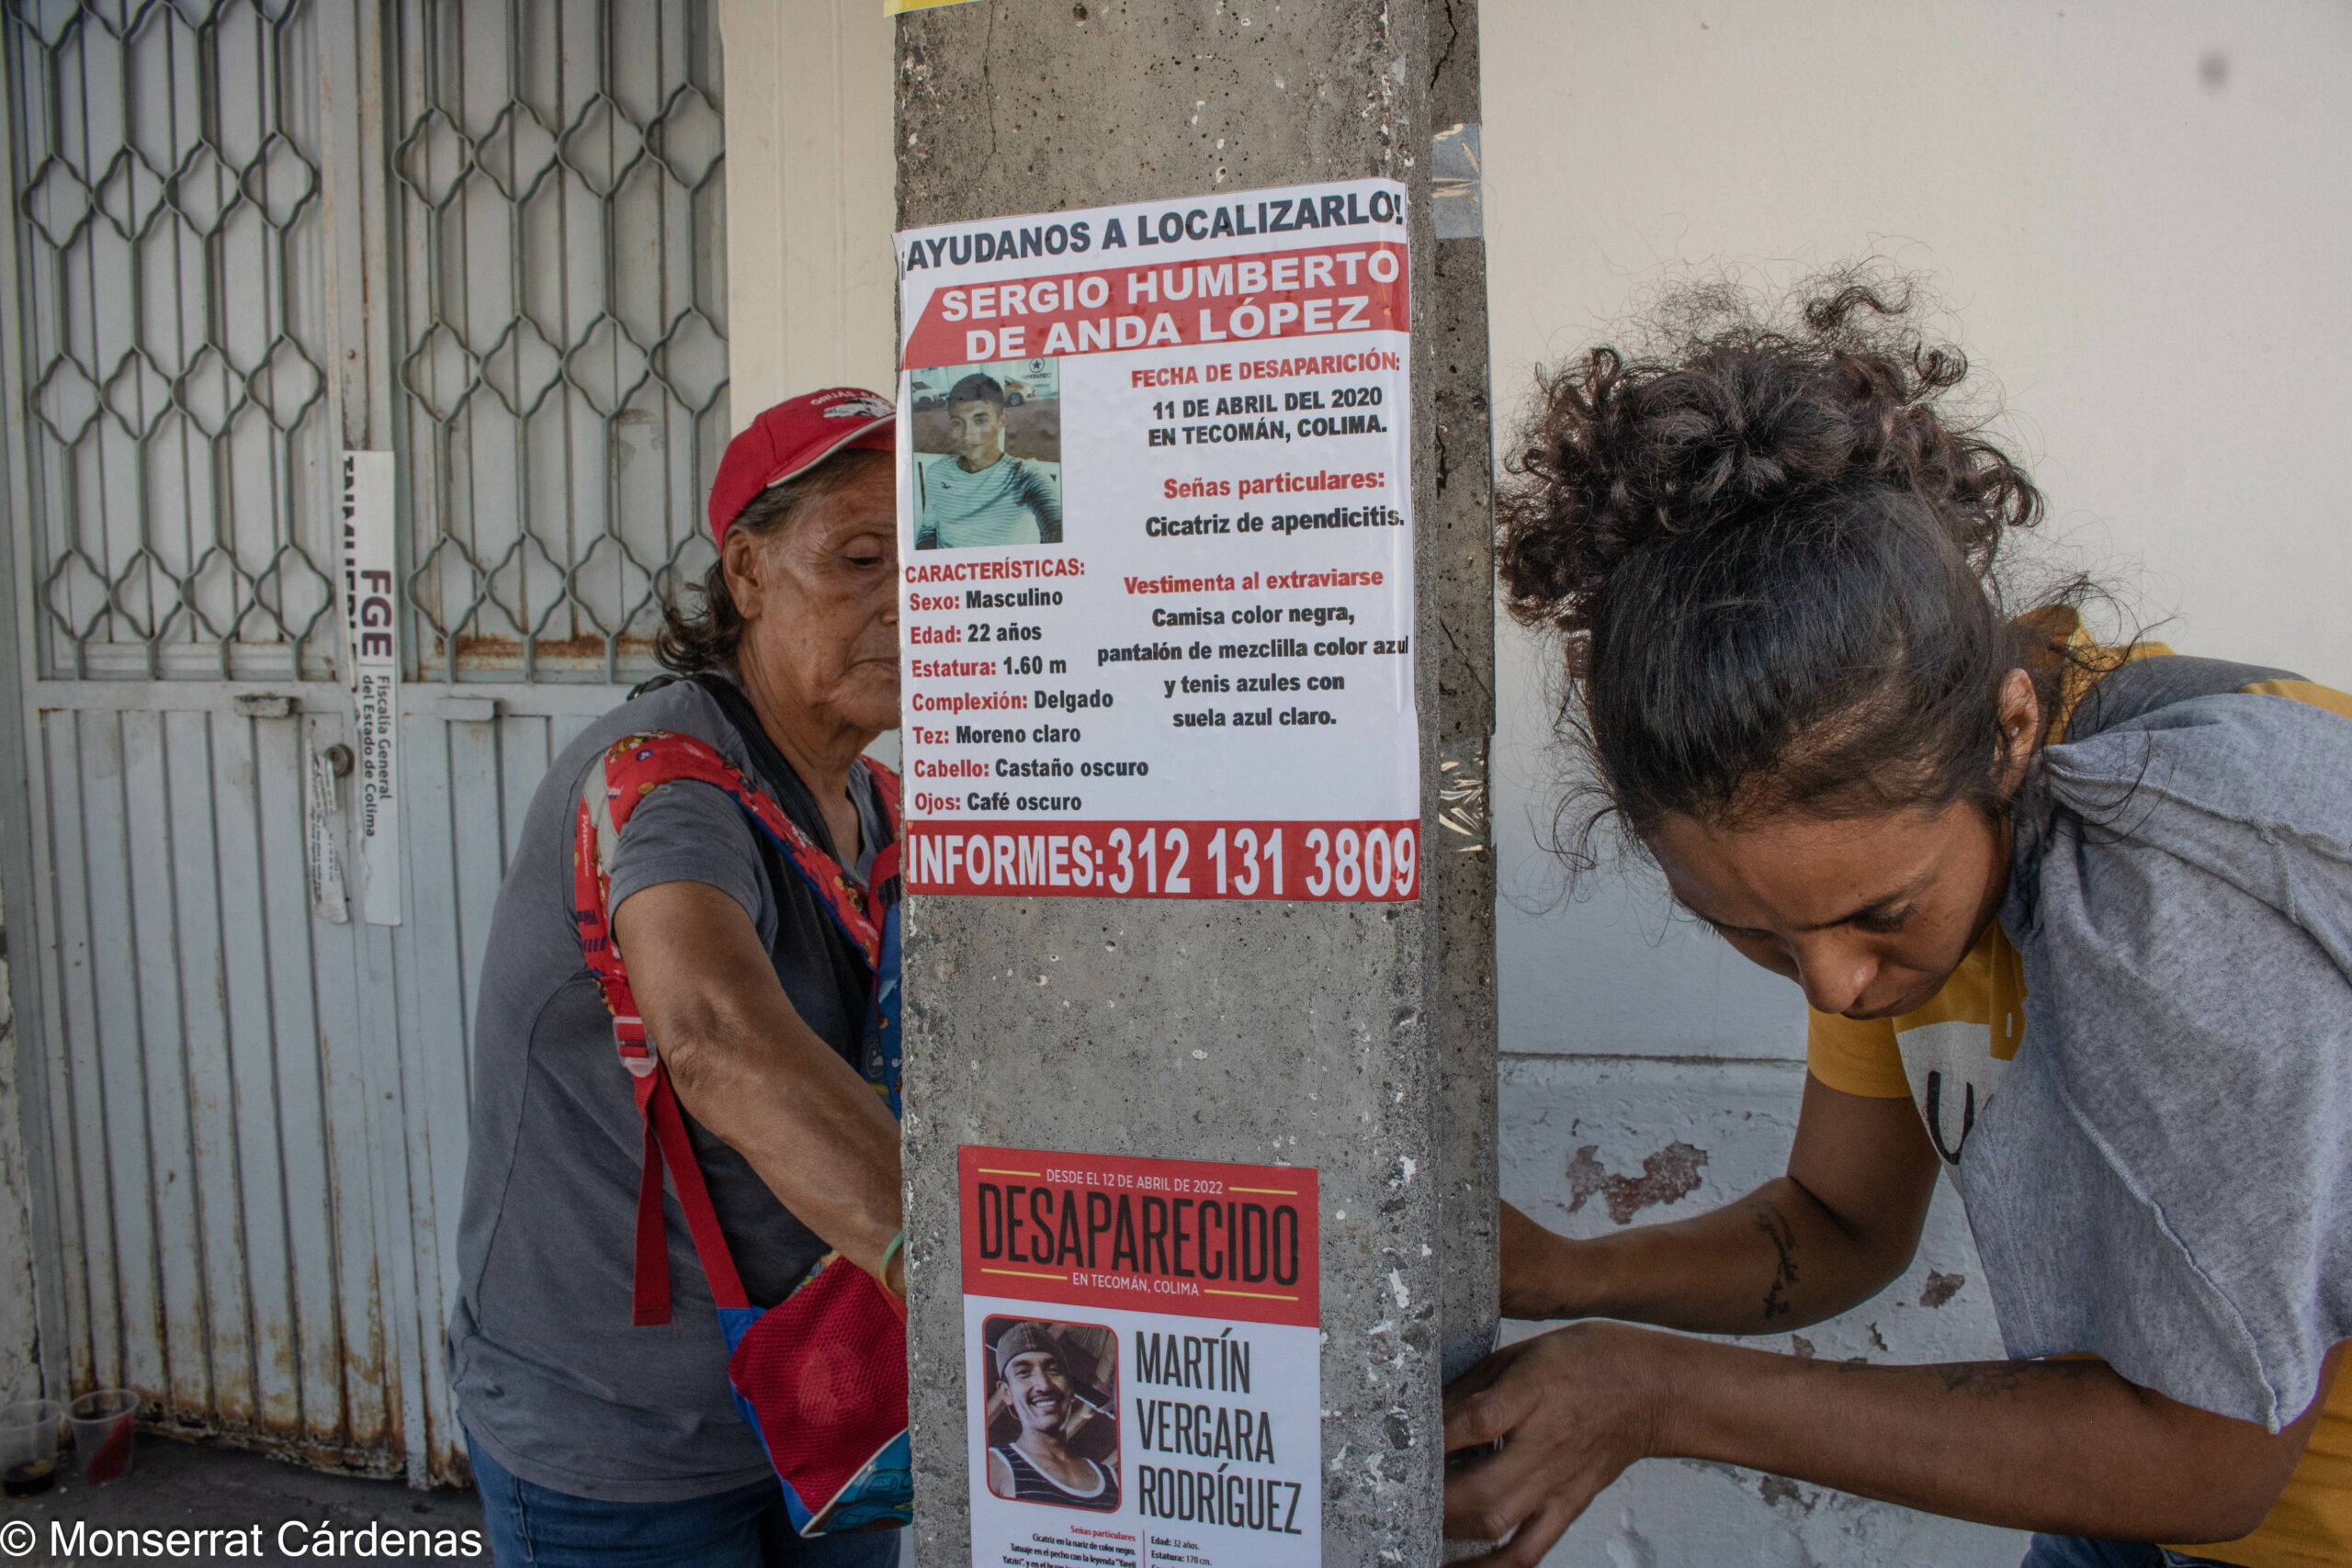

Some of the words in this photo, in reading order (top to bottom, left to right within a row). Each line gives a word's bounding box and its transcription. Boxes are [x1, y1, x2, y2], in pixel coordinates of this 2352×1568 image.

[1102, 221, 1127, 250] A
[1138, 190, 1403, 246] LOCALIZARLO!
[942, 276, 1109, 322] SERGIO
[1128, 249, 1399, 304] HUMBERTO
[966, 325, 1025, 361] DE
[1043, 313, 1182, 355] ANDA
[1199, 297, 1371, 342] LÓPEZ
[1131, 367, 1199, 389] FECHA
[1205, 365, 1232, 382] DE
[1239, 348, 1400, 380] DESAPARICIÓN:
[1152, 402, 1176, 421] 11
[1182, 400, 1210, 419] DE
[1216, 395, 1277, 415] ABRIL
[1284, 391, 1325, 412] DEL
[1330, 386, 1383, 409] 2020
[1148, 429, 1176, 447] EN
[1182, 420, 1291, 446] TECOMÁN,
[1296, 415, 1386, 437] COLIMA.
[1163, 476, 1230, 499] Señas
[1238, 470, 1385, 502] particulares:
[1145, 513, 1230, 537] Cicatriz
[1237, 513, 1264, 533] de
[1271, 505, 1405, 537] apendicitis.
[905, 558, 1085, 583] CARACTERÍSTICAS:
[1124, 574, 1235, 595] Vestimenta
[1242, 571, 1260, 591] al
[1267, 569, 1384, 590] extraviarse
[910, 592, 960, 611] Sexo:
[966, 589, 1063, 609] Masculino
[361, 570, 392, 657] FGE
[1152, 607, 1226, 627] Camisa
[1232, 606, 1283, 625] color
[1289, 604, 1355, 626] negra,
[910, 626, 962, 644] Edad:
[967, 624, 989, 642] 22
[996, 623, 1042, 642] años
[1098, 642, 1182, 665] pantalón
[1188, 641, 1213, 660] de
[1219, 639, 1308, 660] mezclilla
[1314, 637, 1368, 657] color
[1374, 636, 1408, 655] azul
[911, 658, 997, 678] Estatura:
[1003, 657, 1043, 675] 1.60
[1048, 660, 1067, 673] m
[362, 675, 375, 700] del
[1164, 678, 1176, 698] y
[1181, 674, 1230, 694] tenis
[1236, 673, 1301, 692] azules
[1306, 676, 1345, 692] con
[378, 676, 390, 734] Fiscalía
[912, 692, 1028, 716] Complexión:
[1035, 690, 1114, 713] Delgado
[363, 705, 375, 755] Estado
[1172, 709, 1227, 728] suela
[1232, 708, 1272, 727] azul
[1279, 706, 1337, 726] claro.
[913, 727, 950, 744] Tez:
[956, 726, 1025, 744] Moreno
[1033, 726, 1080, 743] claro
[364, 760, 376, 779] de
[378, 739, 392, 799] General
[915, 760, 989, 779] Cabello:
[995, 759, 1074, 777] Castaño
[1080, 761, 1148, 777] oscuro
[365, 784, 377, 837] Colima
[915, 793, 961, 816] Ojos:
[967, 793, 1011, 811] Café
[1016, 795, 1081, 811] oscuro
[908, 833, 1103, 888] INFORMES:
[1108, 827, 1191, 896] 312
[1207, 828, 1284, 896] 131
[1305, 827, 1416, 898] 3809
[1046, 1168, 1084, 1185] DESDE
[1087, 1171, 1100, 1186] EL
[1102, 1172, 1115, 1187] 12
[1117, 1174, 1135, 1188] DE
[1136, 1175, 1171, 1190] ABRIL
[1174, 1177, 1192, 1191] DE
[1193, 1179, 1223, 1194] 2022
[978, 1182, 1299, 1287] DESAPARECIDO
[1073, 1272, 1089, 1286] EN
[1091, 1271, 1151, 1293] TECOMÁN,
[1154, 1280, 1200, 1297] COLIMA
[1136, 1326, 1250, 1394] MARTÍN
[1136, 1398, 1275, 1464] VERGARA
[1138, 1462, 1302, 1535] RODRÍGUEZ
[1033, 1533, 1055, 1543] Cicatriz
[1090, 1541, 1097, 1550] de
[1099, 1543, 1114, 1551] color
[1115, 1547, 1136, 1556] negro.
[1070, 1525, 1091, 1535] Señas
[1092, 1529, 1136, 1541] particulares
[1151, 1536, 1171, 1546] Edad:
[1182, 1541, 1200, 1550] años.
[1151, 1551, 1184, 1562] Estatura:
[1186, 1555, 1198, 1564] 170
[1200, 1558, 1212, 1566] cm.
